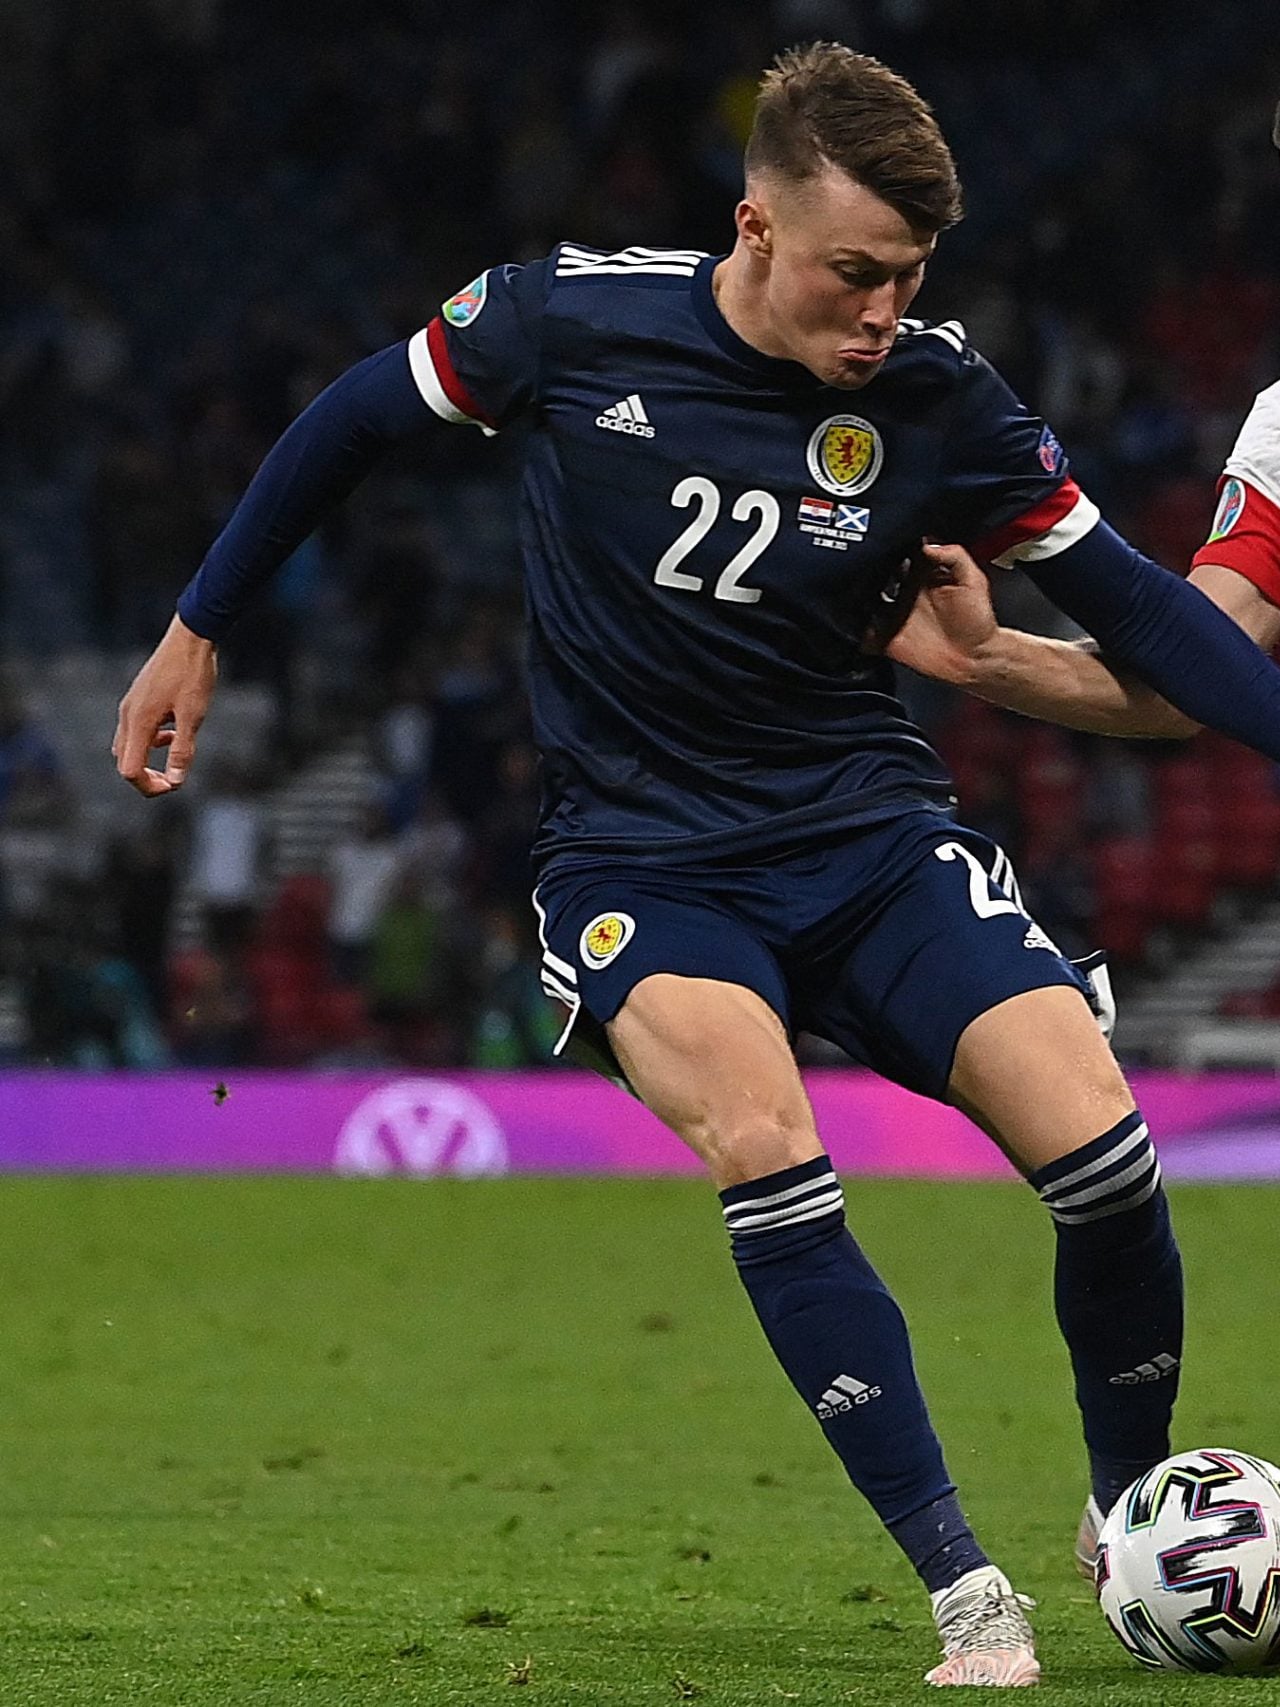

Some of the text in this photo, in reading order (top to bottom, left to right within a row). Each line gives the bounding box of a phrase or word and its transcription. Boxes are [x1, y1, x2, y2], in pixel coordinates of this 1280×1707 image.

[595, 415, 656, 438] adidas
[653, 475, 781, 604] 22
[818, 1385, 882, 1420] adidas
